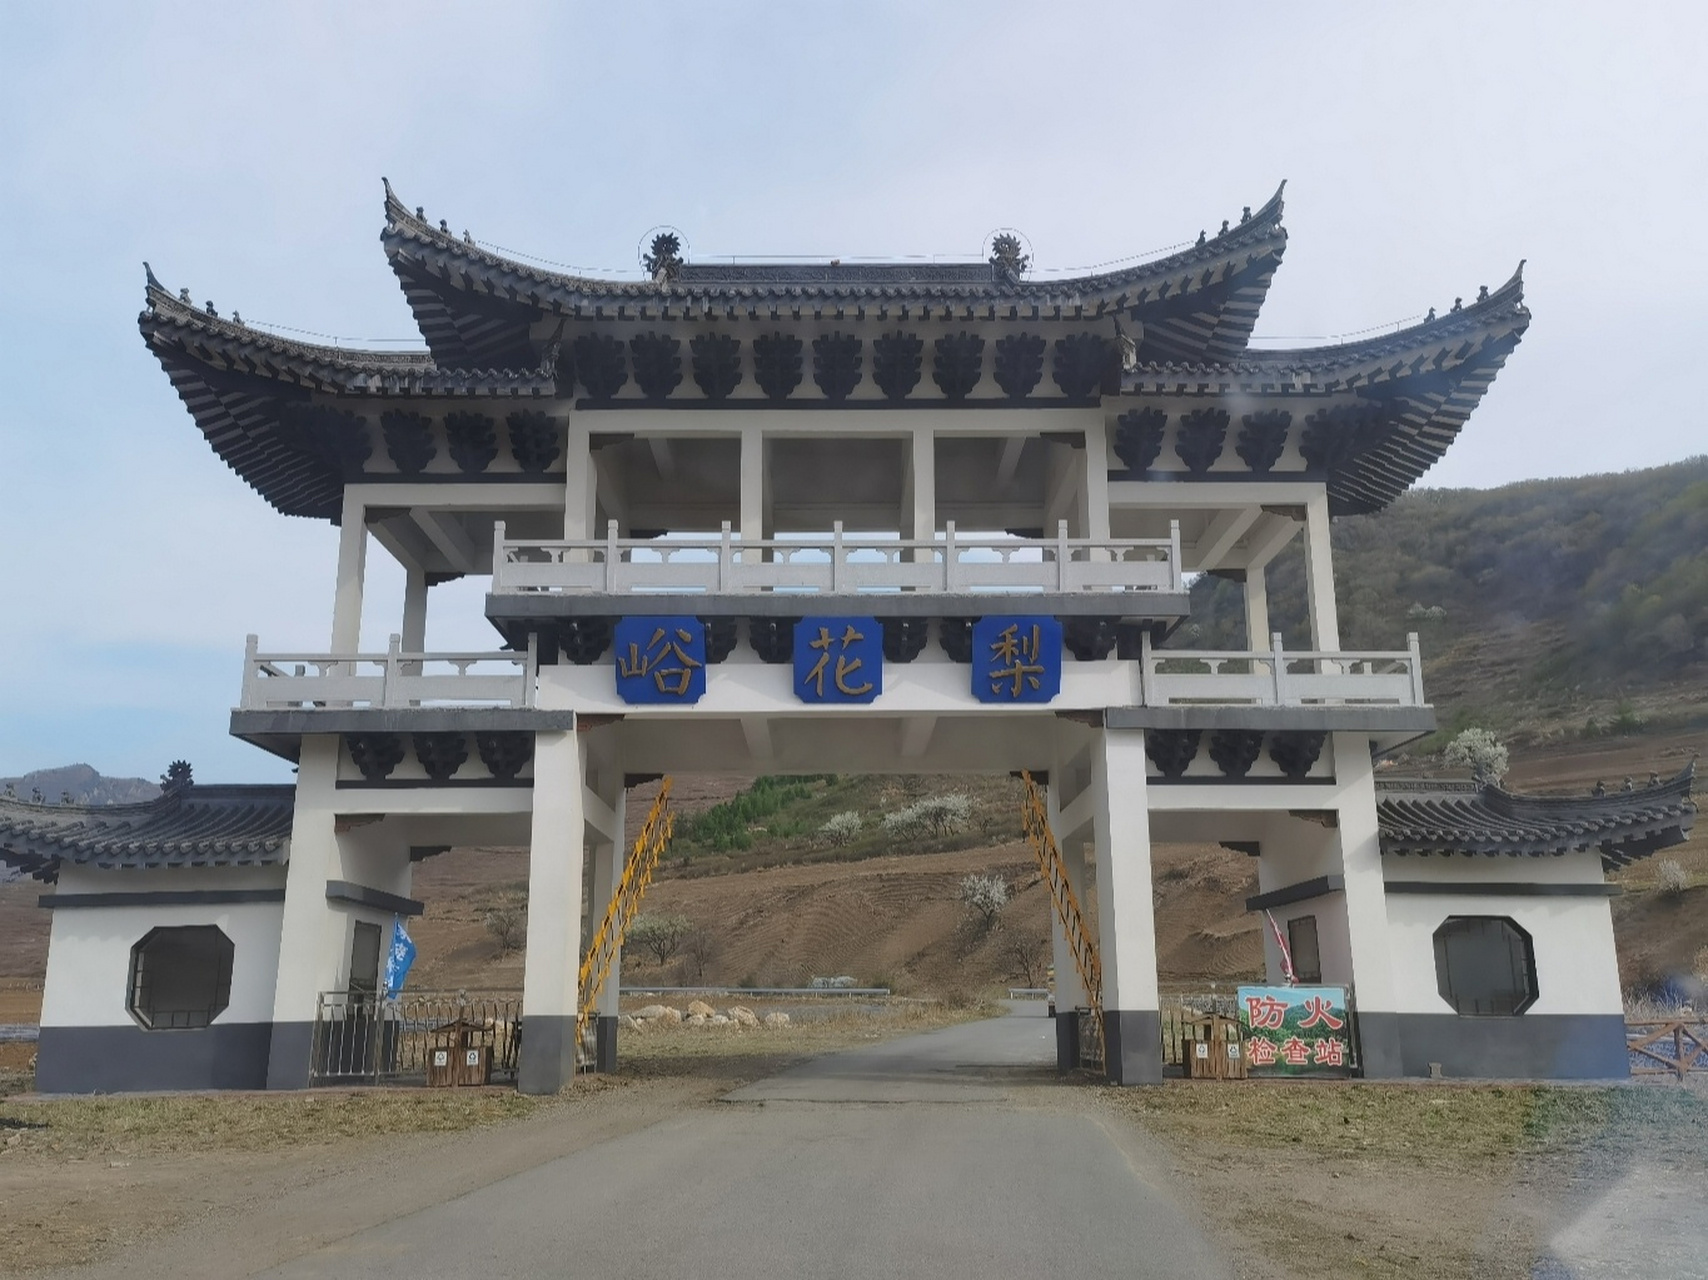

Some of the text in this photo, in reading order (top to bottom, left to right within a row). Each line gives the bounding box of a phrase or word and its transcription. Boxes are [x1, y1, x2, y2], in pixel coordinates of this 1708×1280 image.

[1246, 995, 1343, 1029] 防火
[1248, 1037, 1343, 1065] 检查站
